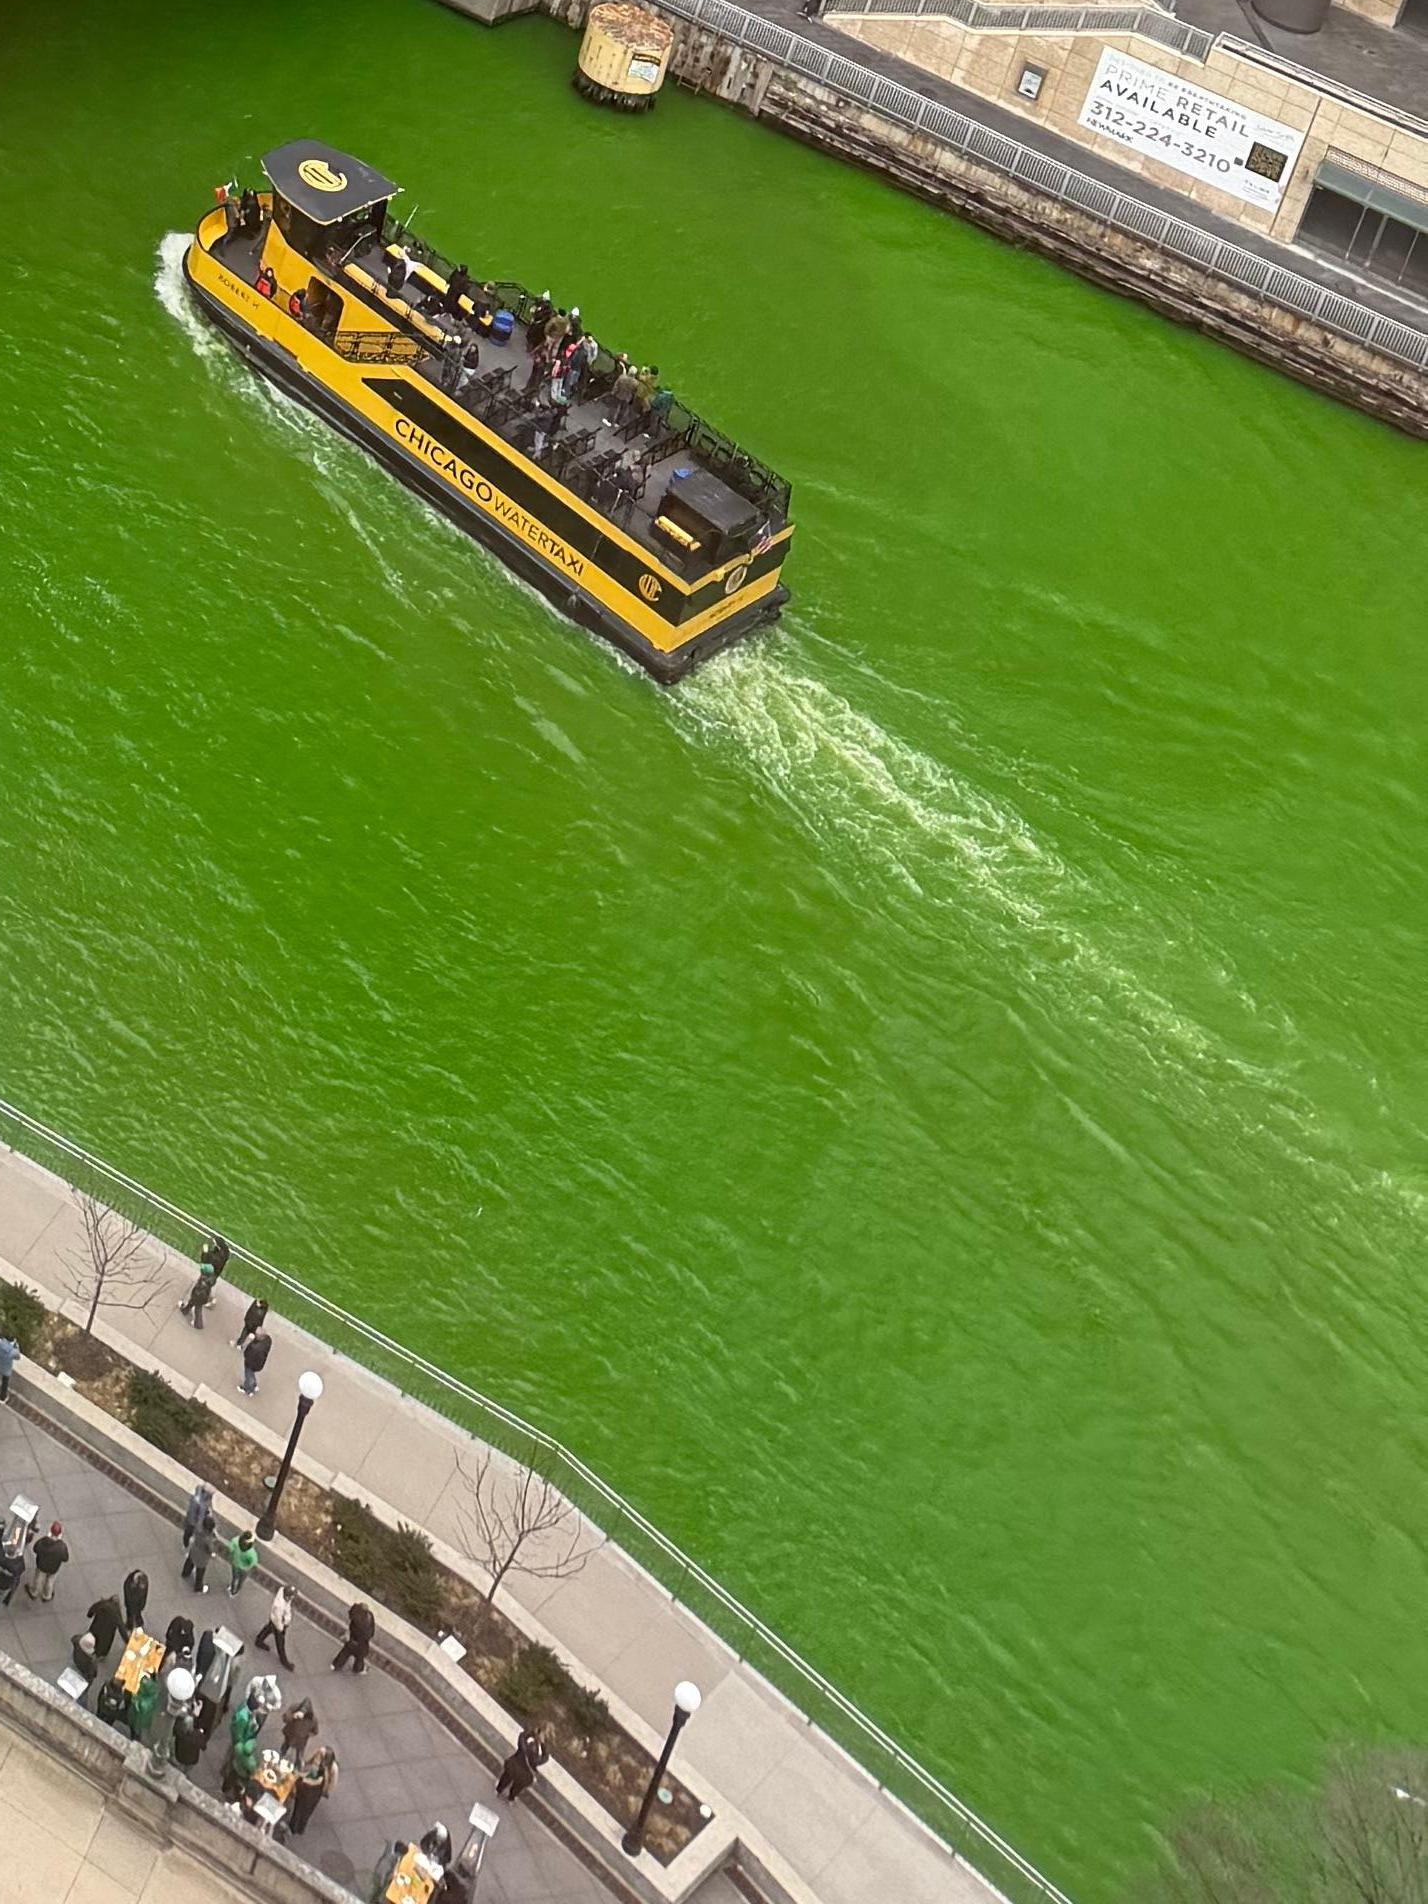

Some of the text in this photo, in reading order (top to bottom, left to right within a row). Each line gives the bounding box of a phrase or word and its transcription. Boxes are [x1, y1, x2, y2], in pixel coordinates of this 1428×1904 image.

[1090, 100, 1231, 174] 312-224-3210
[1099, 79, 1218, 139] AVAILABLE
[1104, 64, 1171, 102] PRIME
[1176, 95, 1250, 139] RETAIL
[395, 418, 493, 503] CHICAGO
